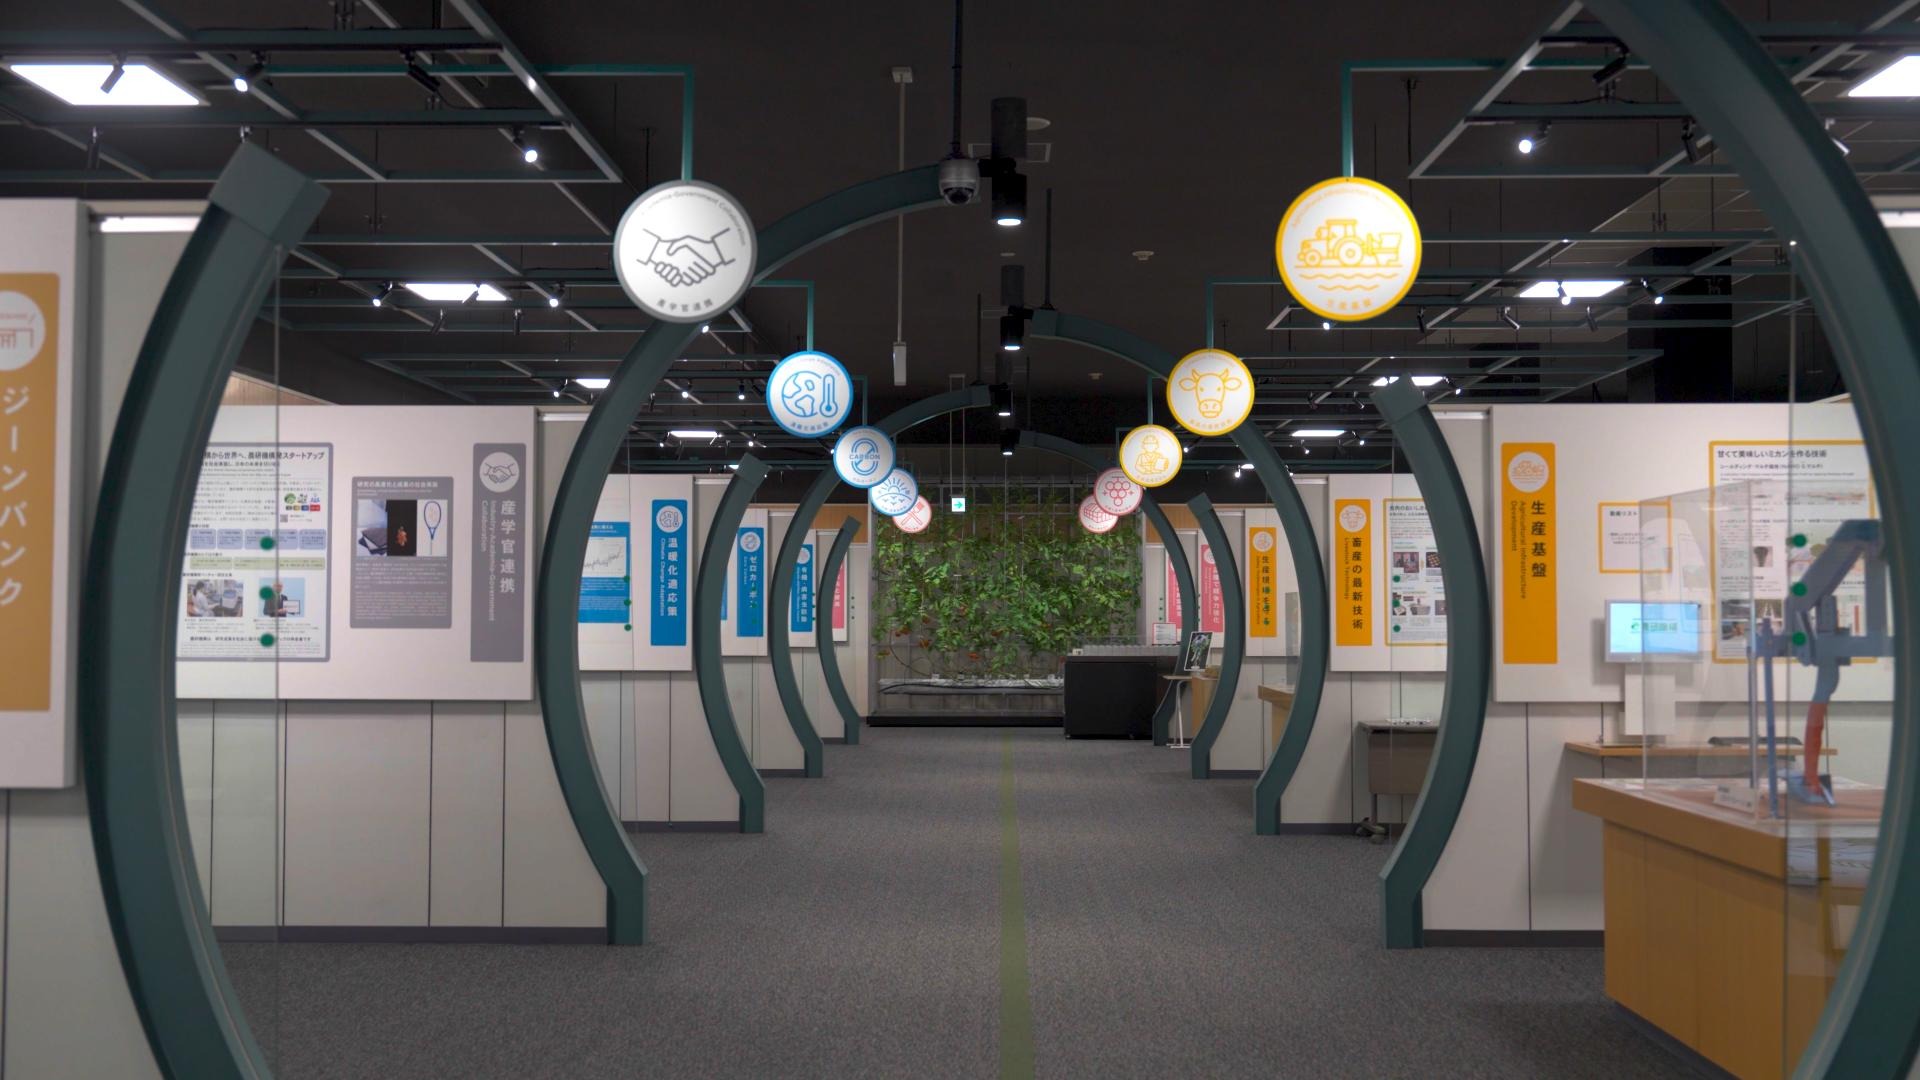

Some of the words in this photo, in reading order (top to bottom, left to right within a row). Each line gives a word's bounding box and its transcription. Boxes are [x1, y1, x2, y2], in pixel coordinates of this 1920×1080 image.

[480, 500, 488, 552] Collaboration
[500, 500, 516, 593] 産学官連携
[1519, 501, 1527, 546] Agricultural
[1531, 500, 1547, 577] 生産基盤
[667, 537, 679, 617] 温暖化適応策
[1352, 537, 1363, 630] 畜産の最新技術
